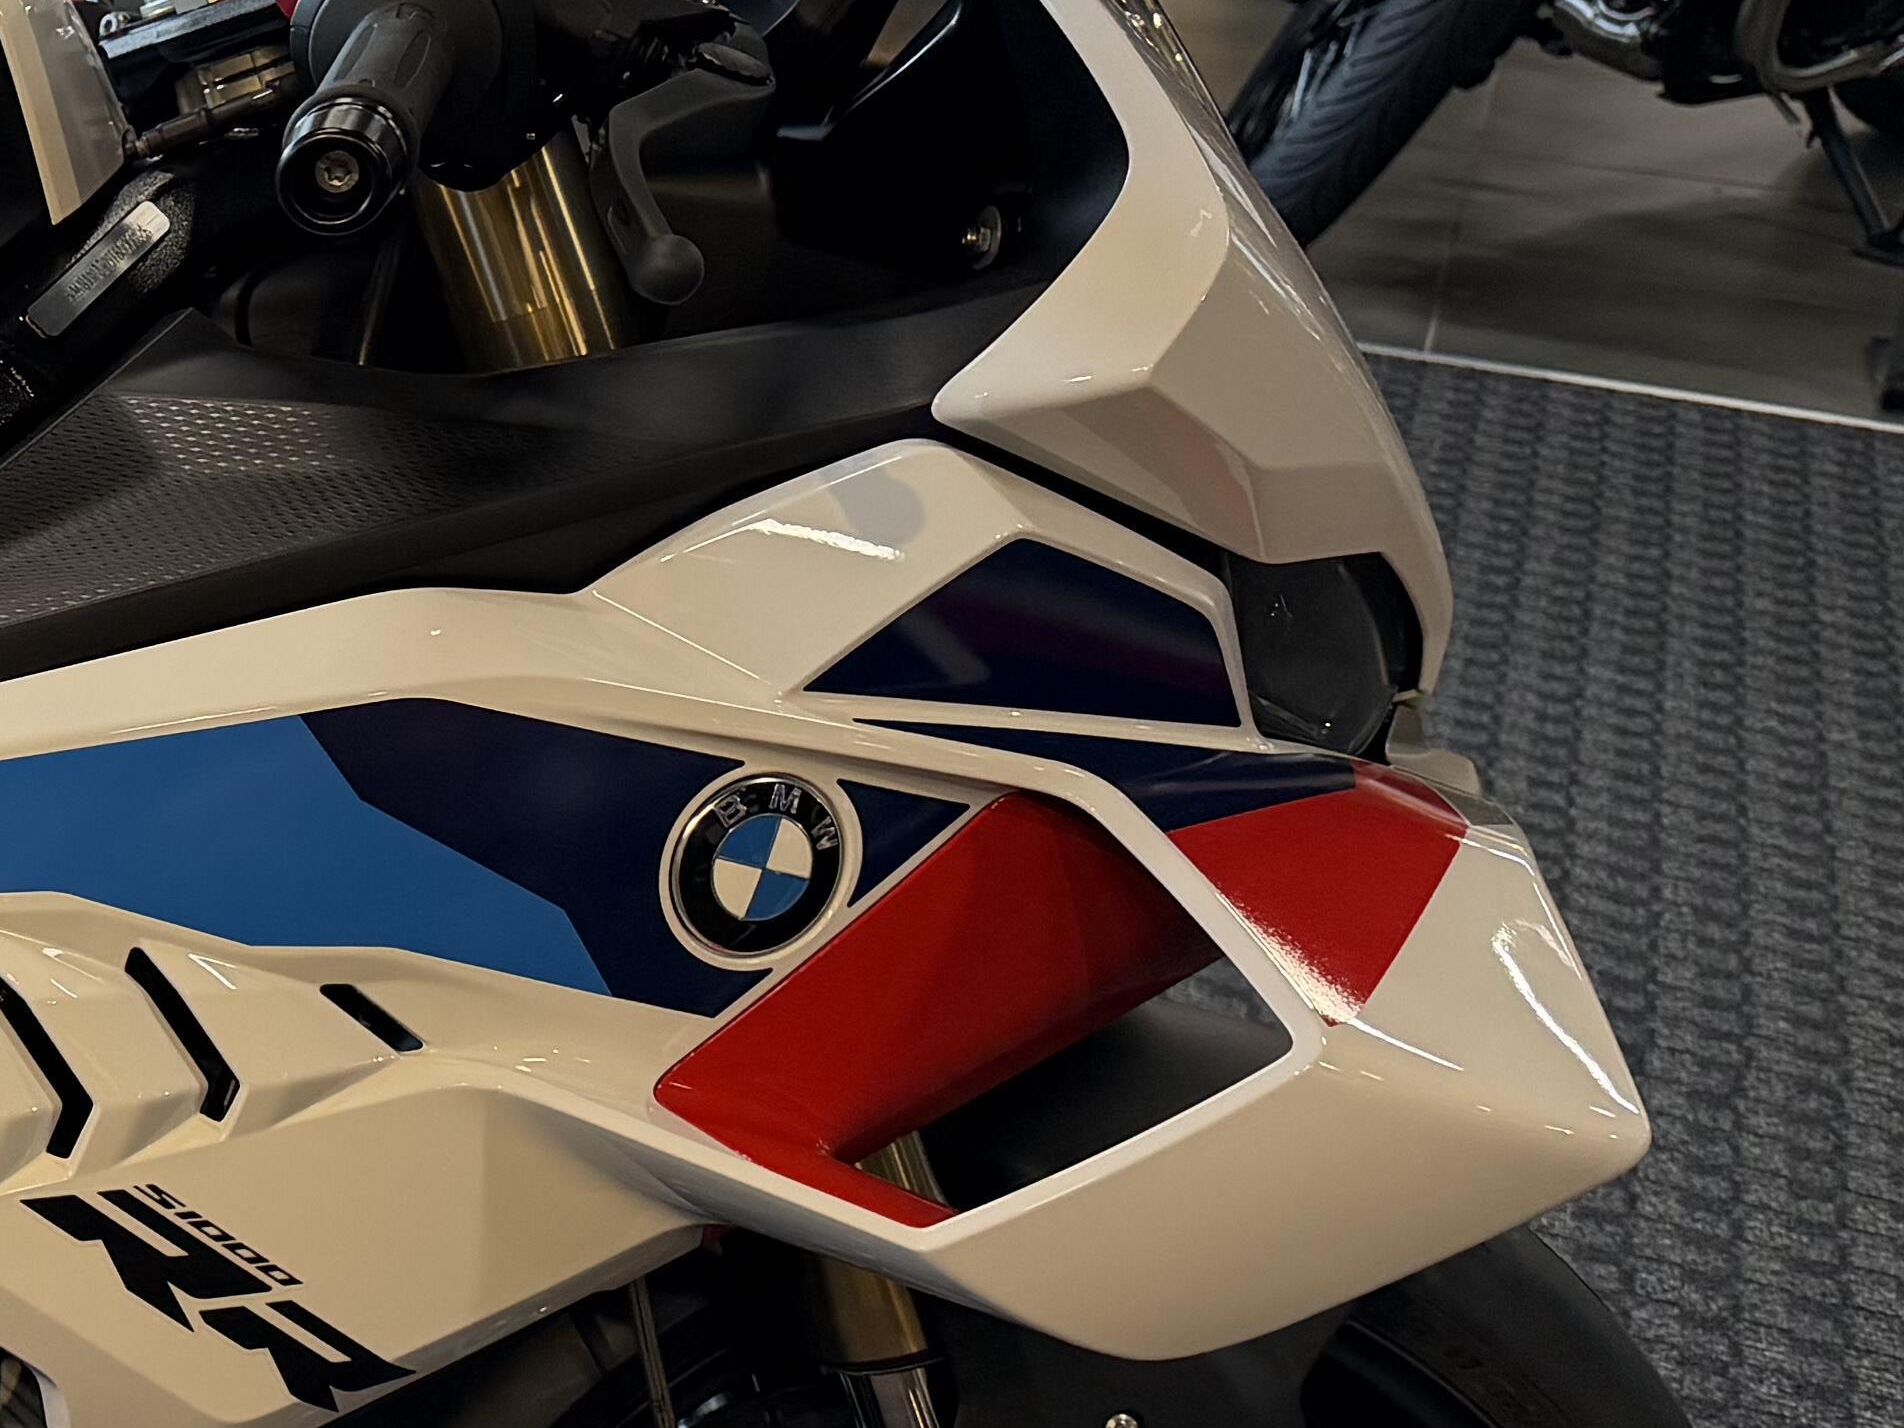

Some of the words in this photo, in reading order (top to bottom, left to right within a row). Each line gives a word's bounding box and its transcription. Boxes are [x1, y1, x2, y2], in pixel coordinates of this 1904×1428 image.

[713, 782, 840, 852] BMW
[132, 1183, 304, 1286] S1000
[19, 1188, 417, 1413] RR
